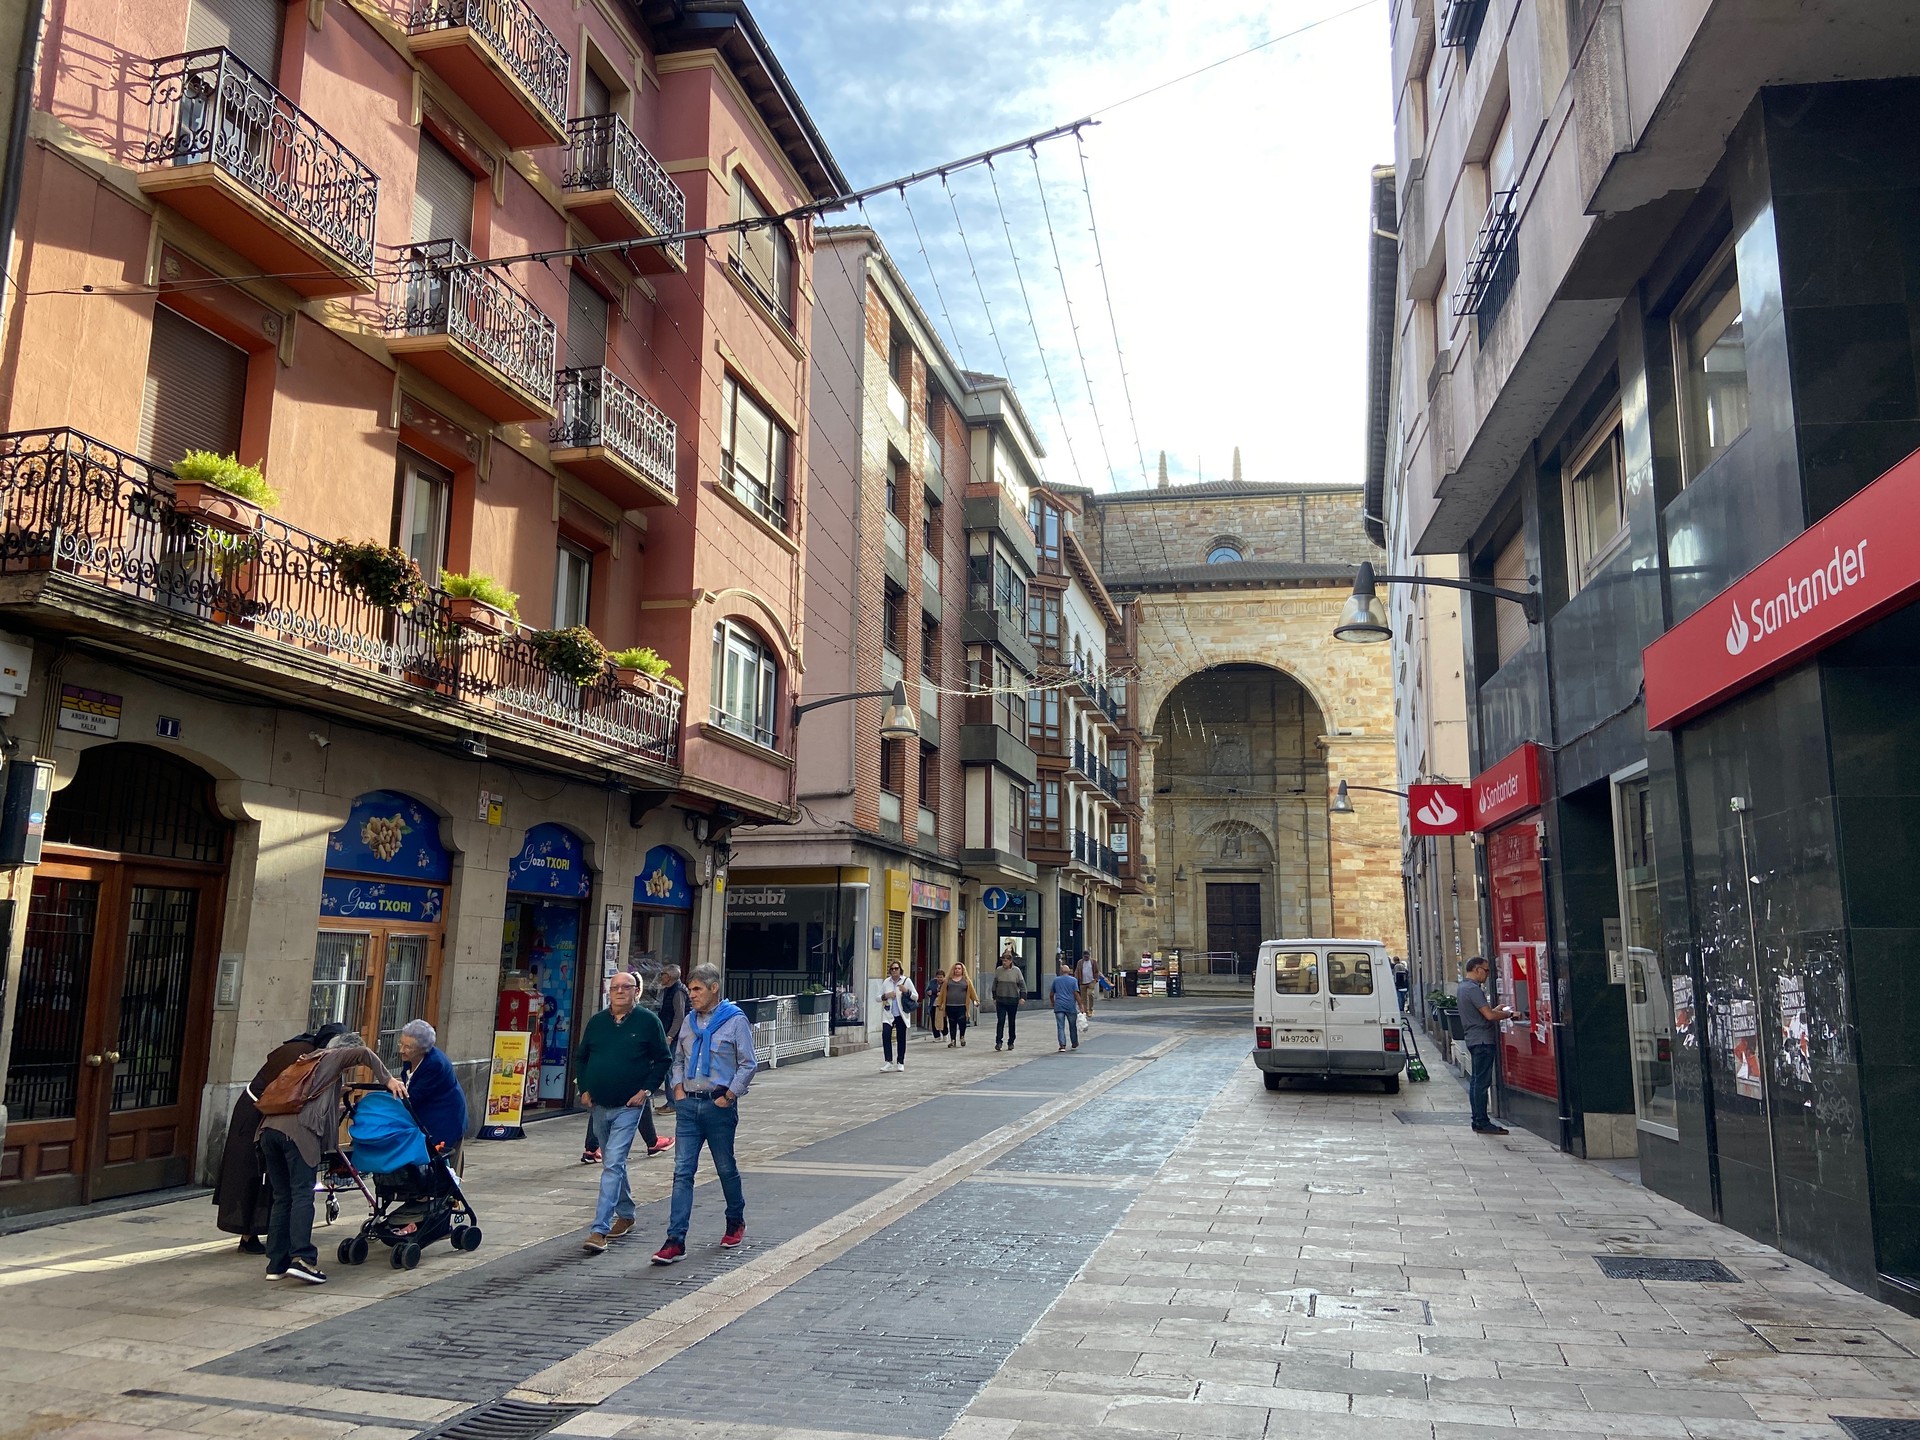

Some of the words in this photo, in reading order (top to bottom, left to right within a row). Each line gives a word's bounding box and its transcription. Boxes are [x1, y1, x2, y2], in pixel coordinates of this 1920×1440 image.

[1751, 539, 1867, 642] Santander
[71, 712, 88, 722] ANDRA
[91, 716, 107, 725] MARIA
[80, 723, 97, 731] KALEA
[167, 721, 173, 736] 1
[1486, 773, 1519, 810] Santander
[546, 857, 570, 871] TXORI
[378, 900, 411, 913] TXORI
